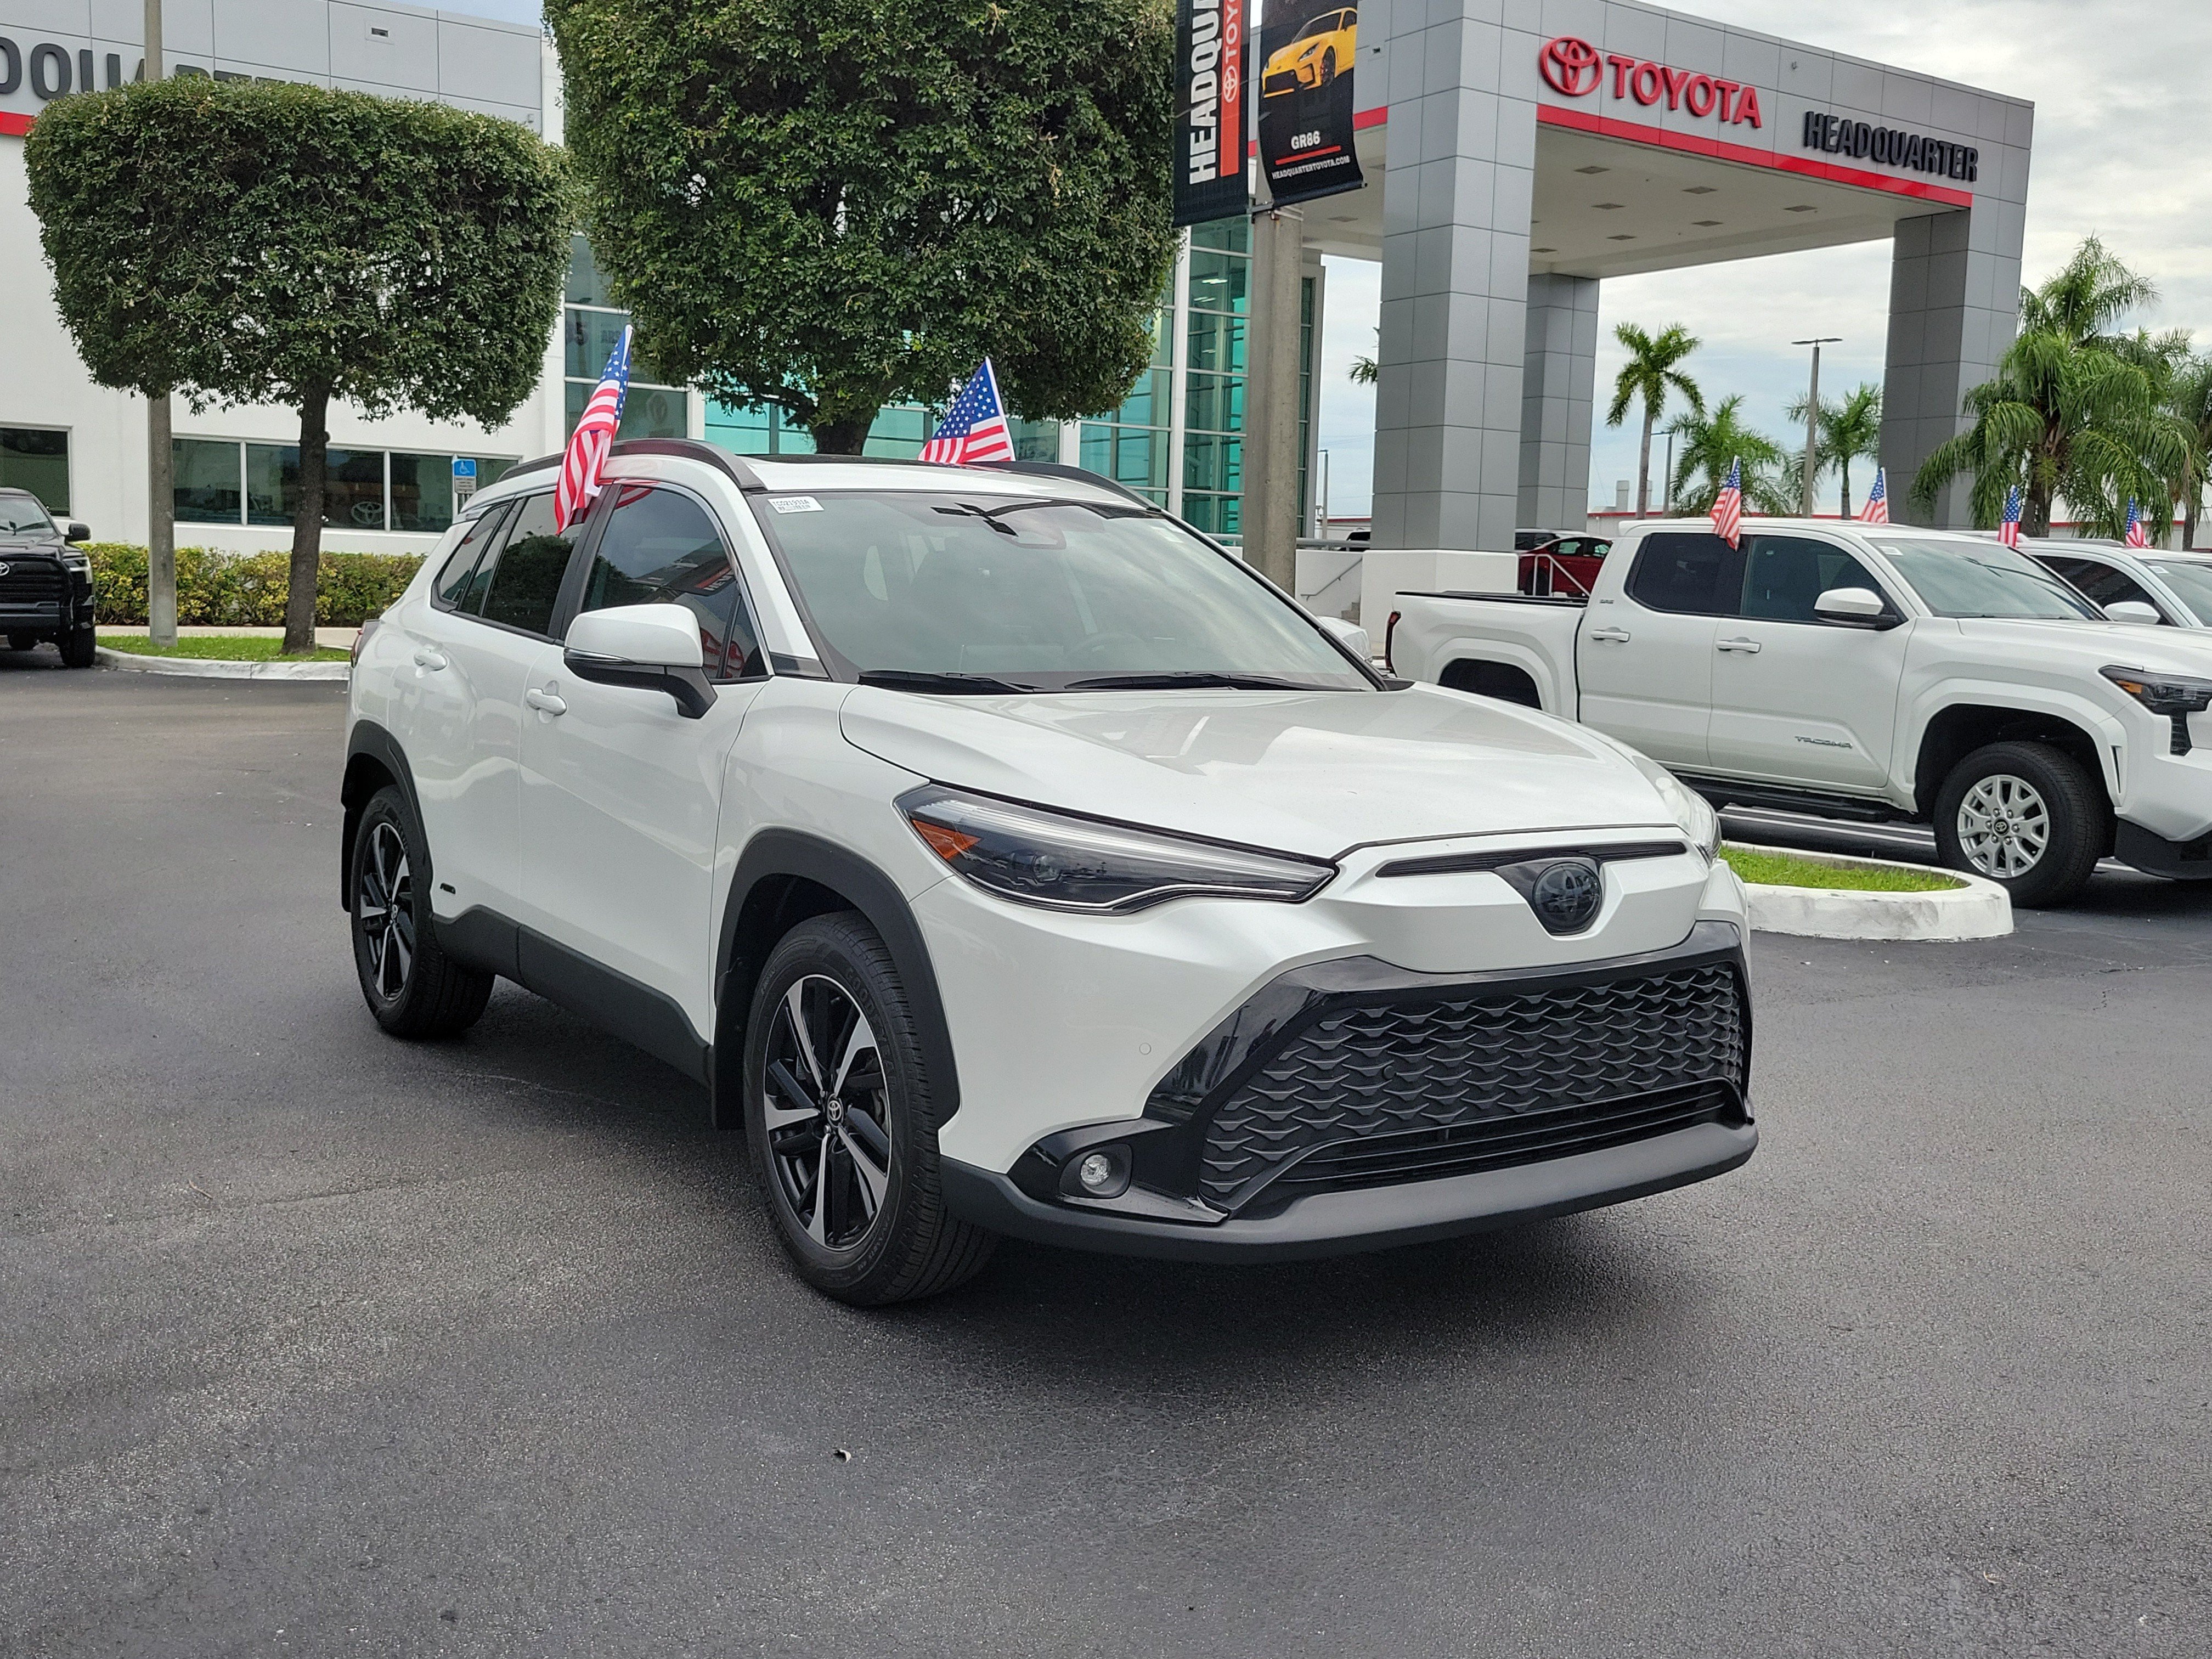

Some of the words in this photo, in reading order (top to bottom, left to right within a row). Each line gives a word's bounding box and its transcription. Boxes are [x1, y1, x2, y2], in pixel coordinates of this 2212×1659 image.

[1225, 0, 1238, 65] TOY
[1189, 0, 1222, 184] HEADQU
[1608, 54, 1762, 129] TOYOTA
[1271, 155, 1351, 180] HEADQUARTERTOYOTA.COM
[1290, 131, 1321, 150] GR86
[1803, 111, 1979, 182] HEADQUARTER
